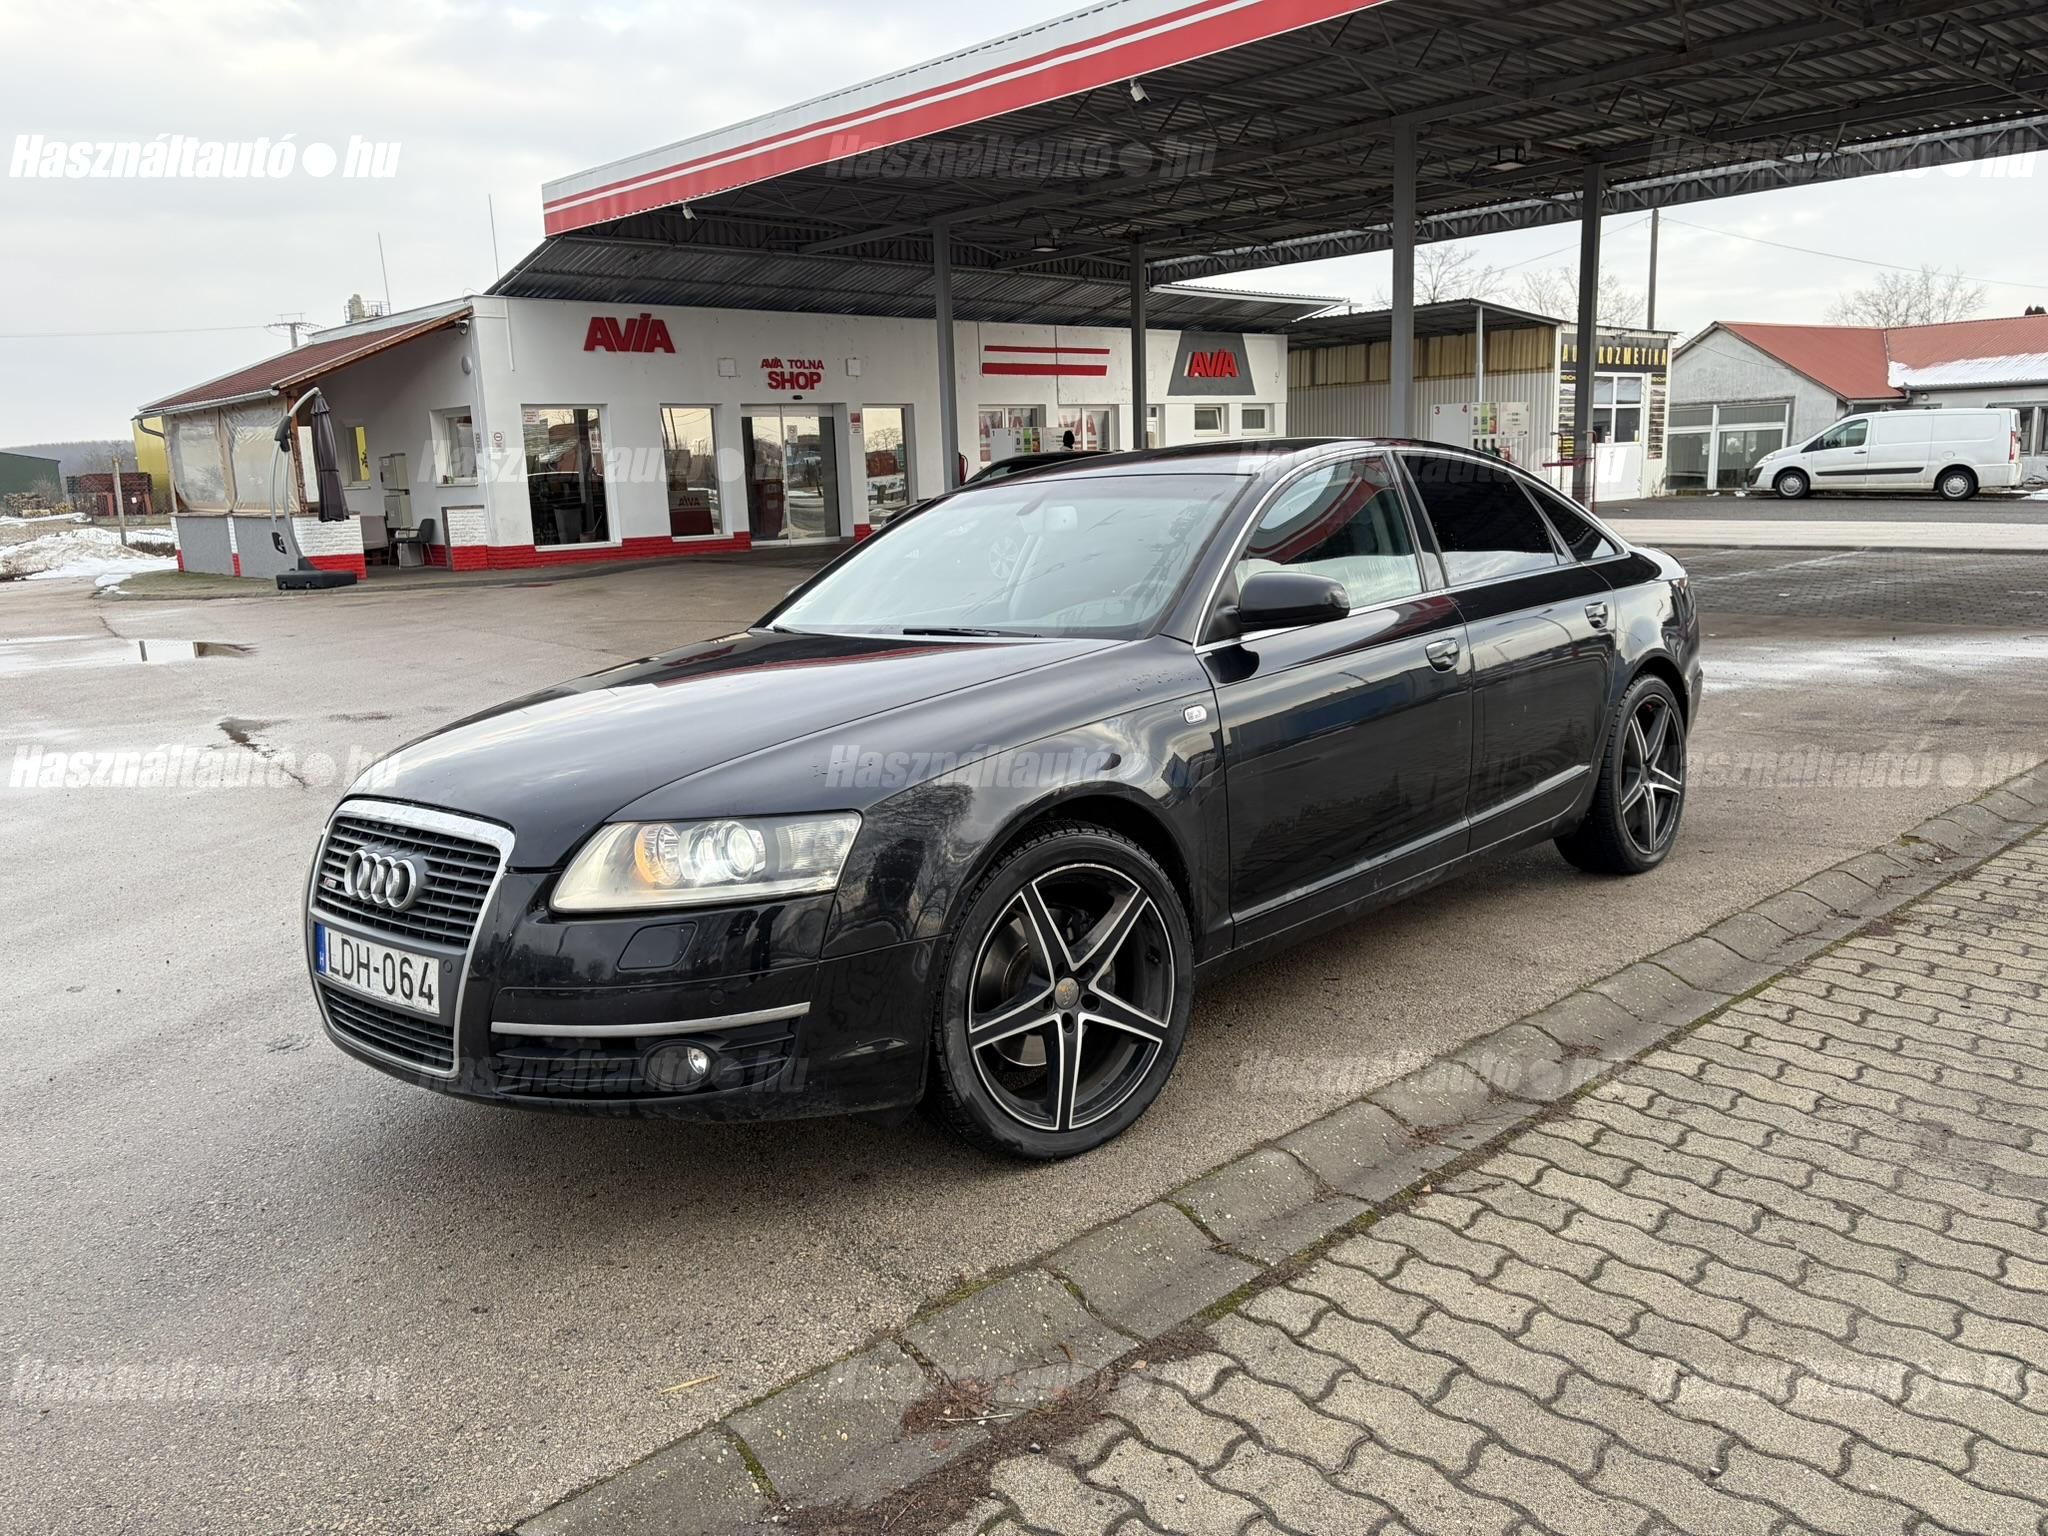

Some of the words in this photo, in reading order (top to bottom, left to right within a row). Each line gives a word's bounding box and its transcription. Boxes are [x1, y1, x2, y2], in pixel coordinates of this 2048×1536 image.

[583, 312, 676, 353] AVIA
[761, 356, 783, 369] AVIA
[787, 359, 825, 370] TOLNA
[1186, 347, 1240, 377] AVIA
[767, 370, 822, 390] SHOP
[328, 932, 434, 1006] LDH-064
